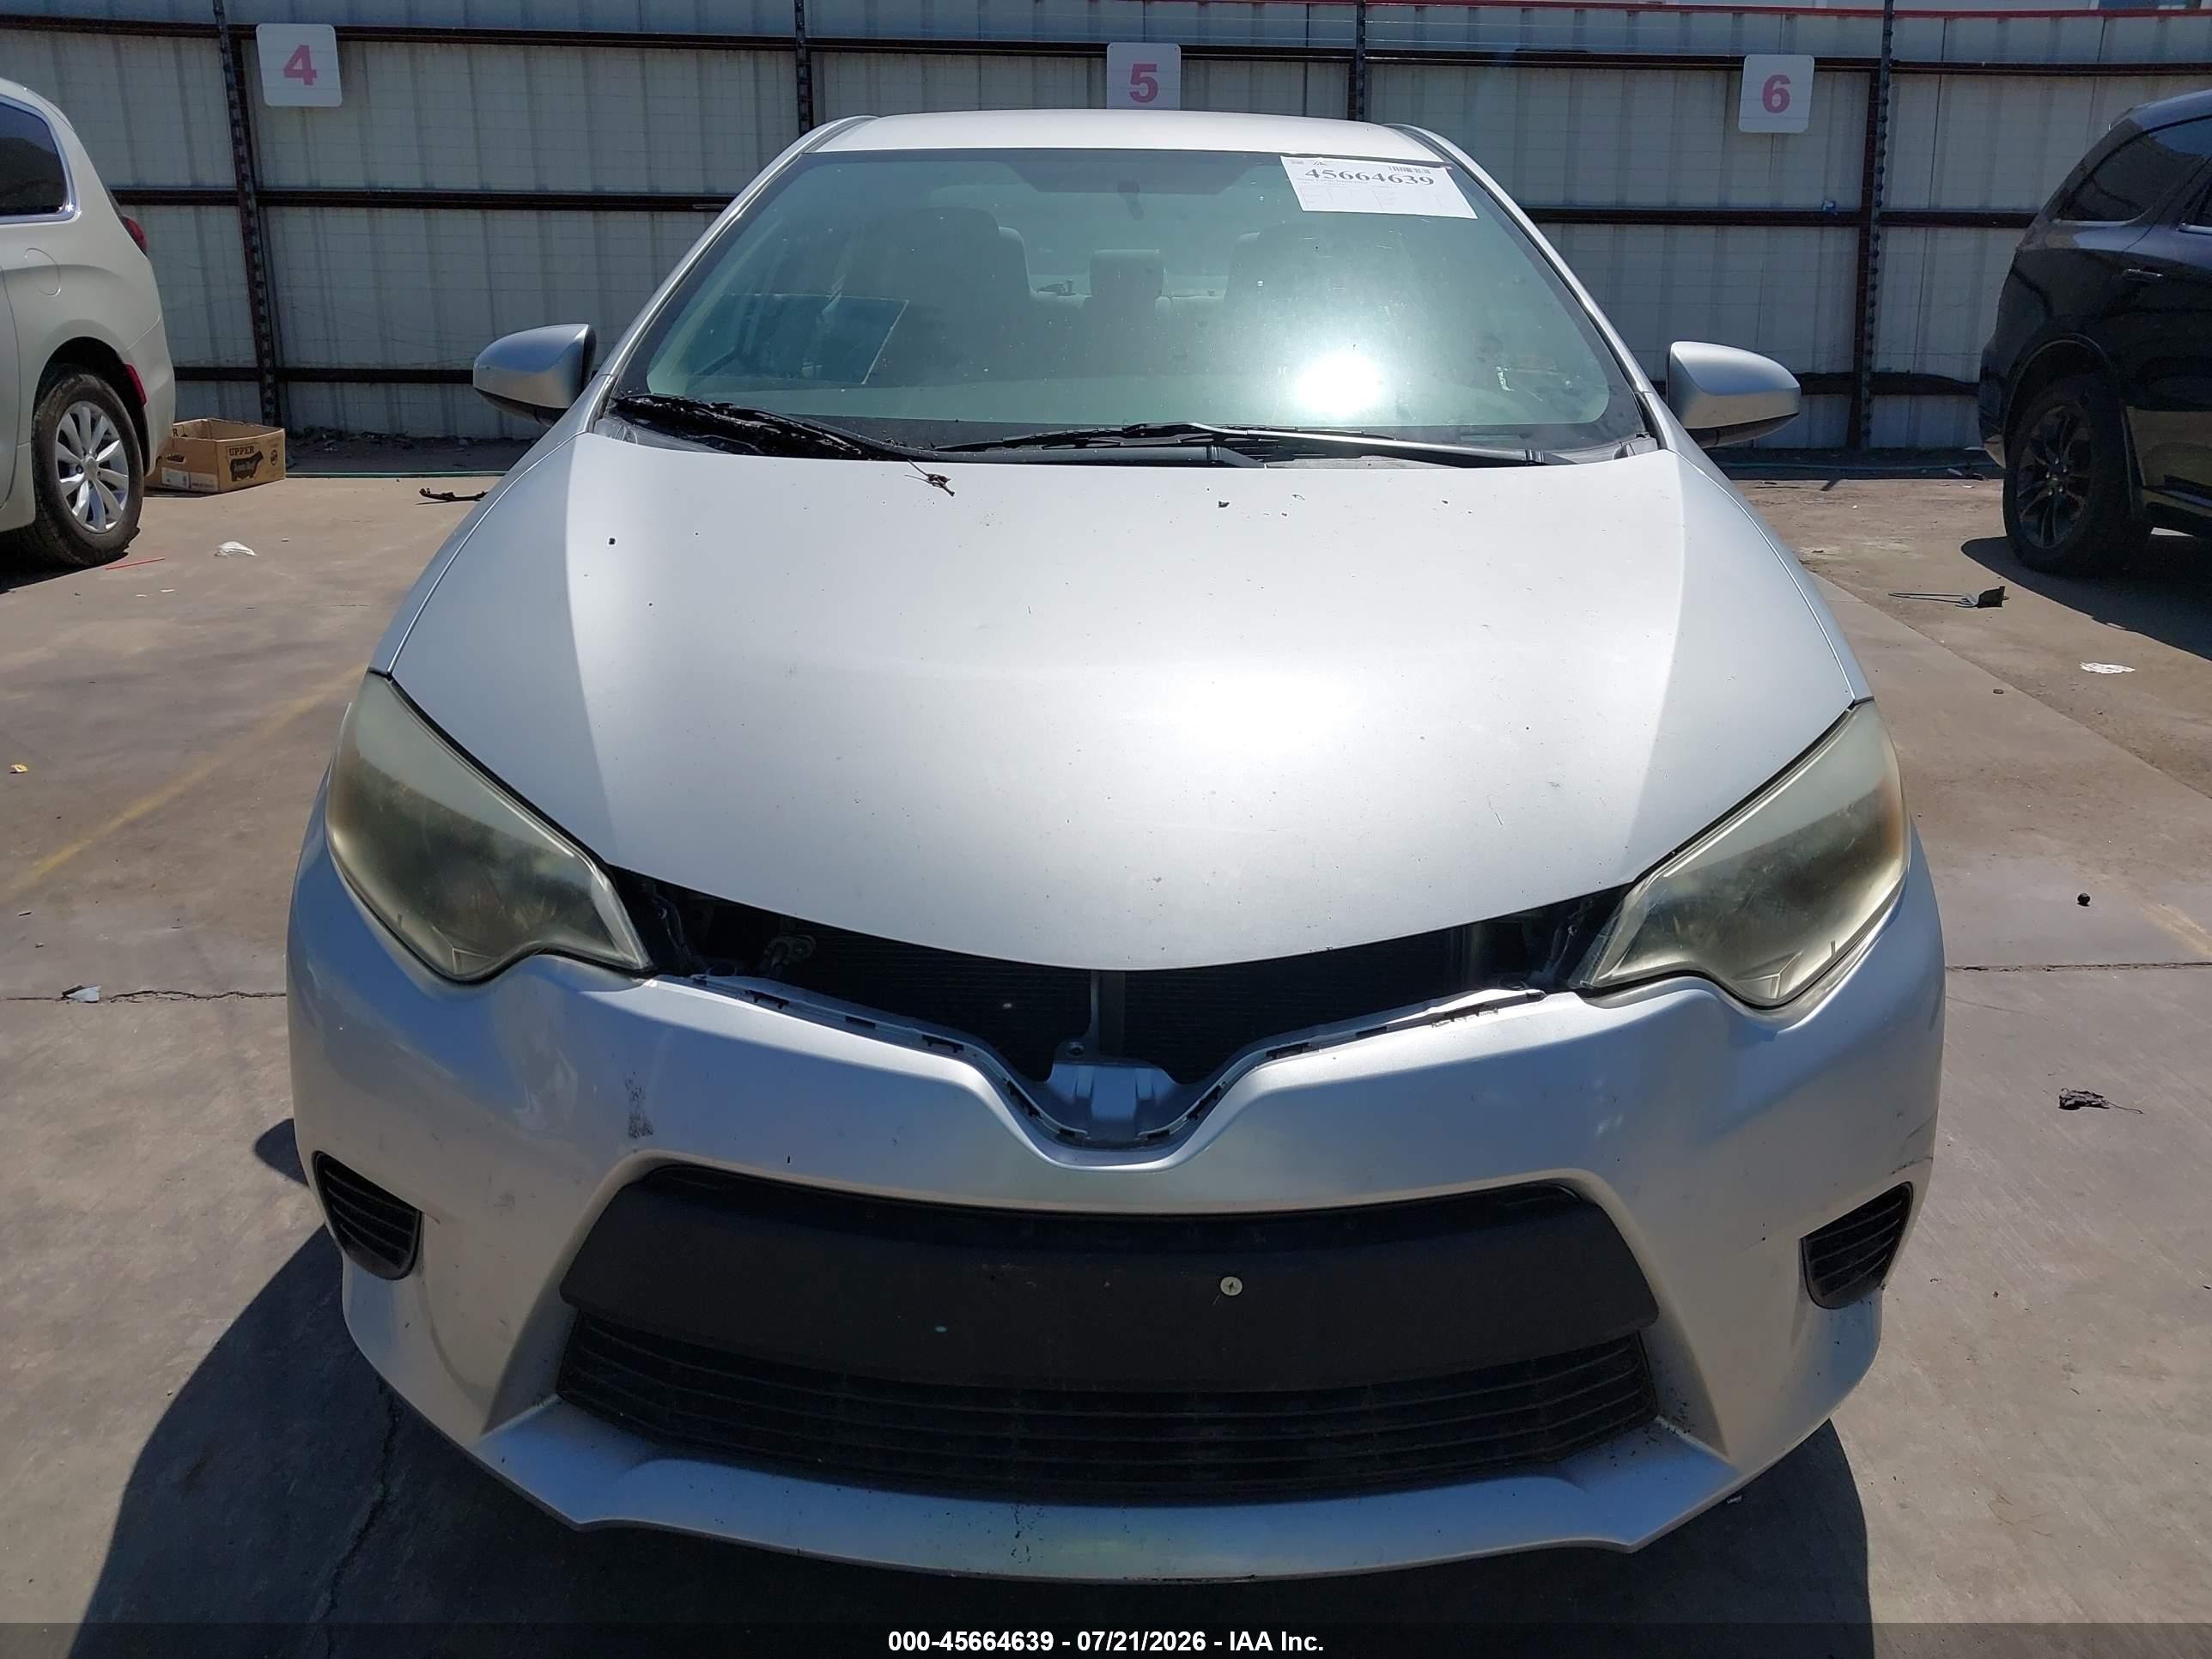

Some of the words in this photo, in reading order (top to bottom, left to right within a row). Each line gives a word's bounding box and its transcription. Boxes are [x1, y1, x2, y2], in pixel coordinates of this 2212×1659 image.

[283, 45, 317, 86] 4
[1129, 64, 1158, 103] 5
[1763, 75, 1790, 113] 6
[1304, 168, 1435, 186] 45664639
[228, 446, 255, 456] UPPER
